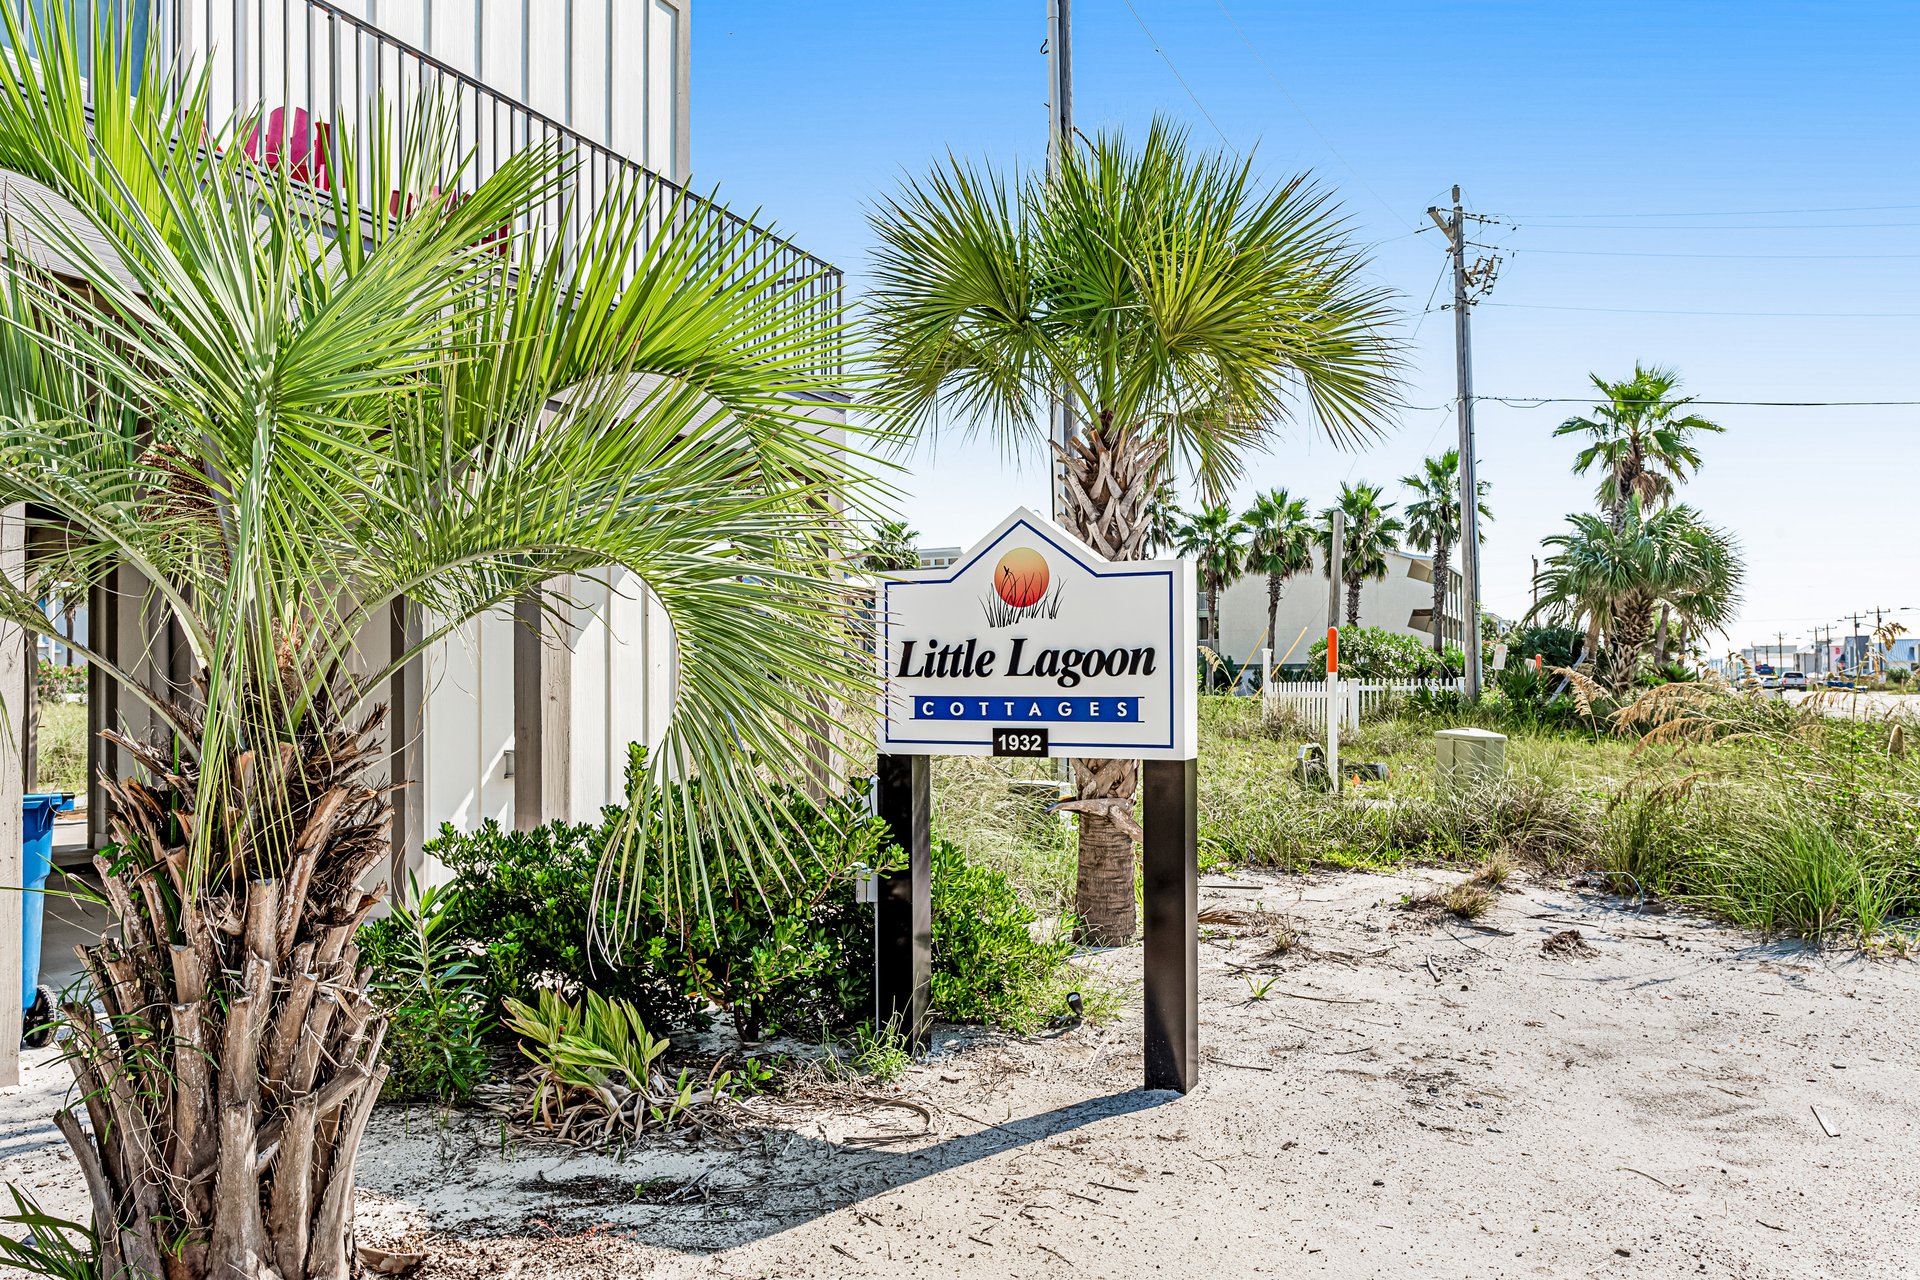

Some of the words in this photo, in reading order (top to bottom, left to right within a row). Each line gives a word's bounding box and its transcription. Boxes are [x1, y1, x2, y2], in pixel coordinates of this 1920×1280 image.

[896, 638, 996, 678] Little
[1004, 638, 1156, 688] Lagoon
[922, 702, 1128, 717] COTTAGES
[998, 734, 1042, 751] 1932
